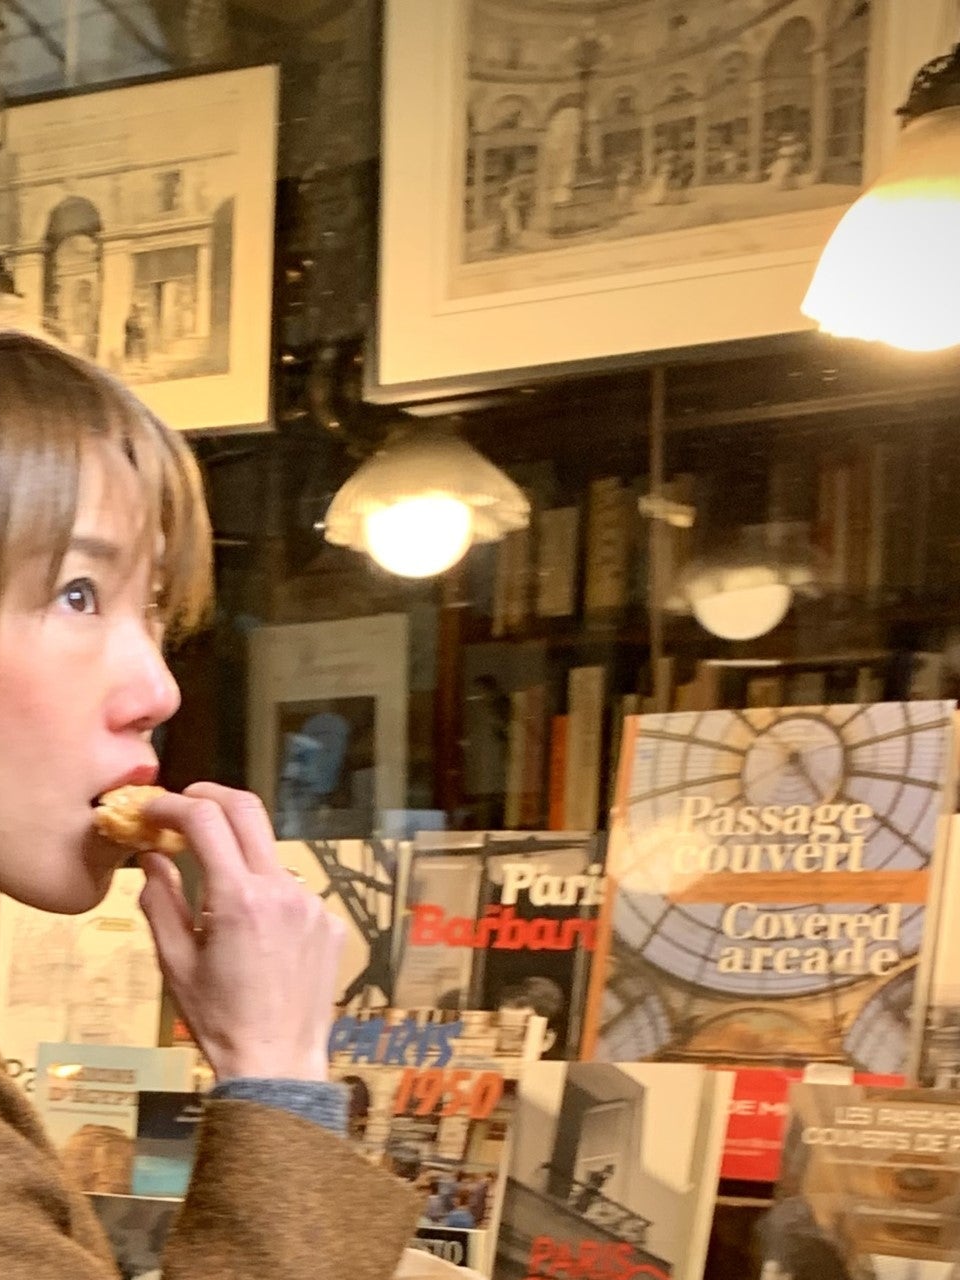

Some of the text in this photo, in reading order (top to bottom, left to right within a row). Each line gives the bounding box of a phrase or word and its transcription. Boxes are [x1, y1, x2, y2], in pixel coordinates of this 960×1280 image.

[676, 796, 873, 843] Passage
[671, 836, 868, 873] couvert
[721, 902, 901, 941] Covered
[716, 937, 901, 977] arcade
[393, 1067, 503, 1118] 1950
